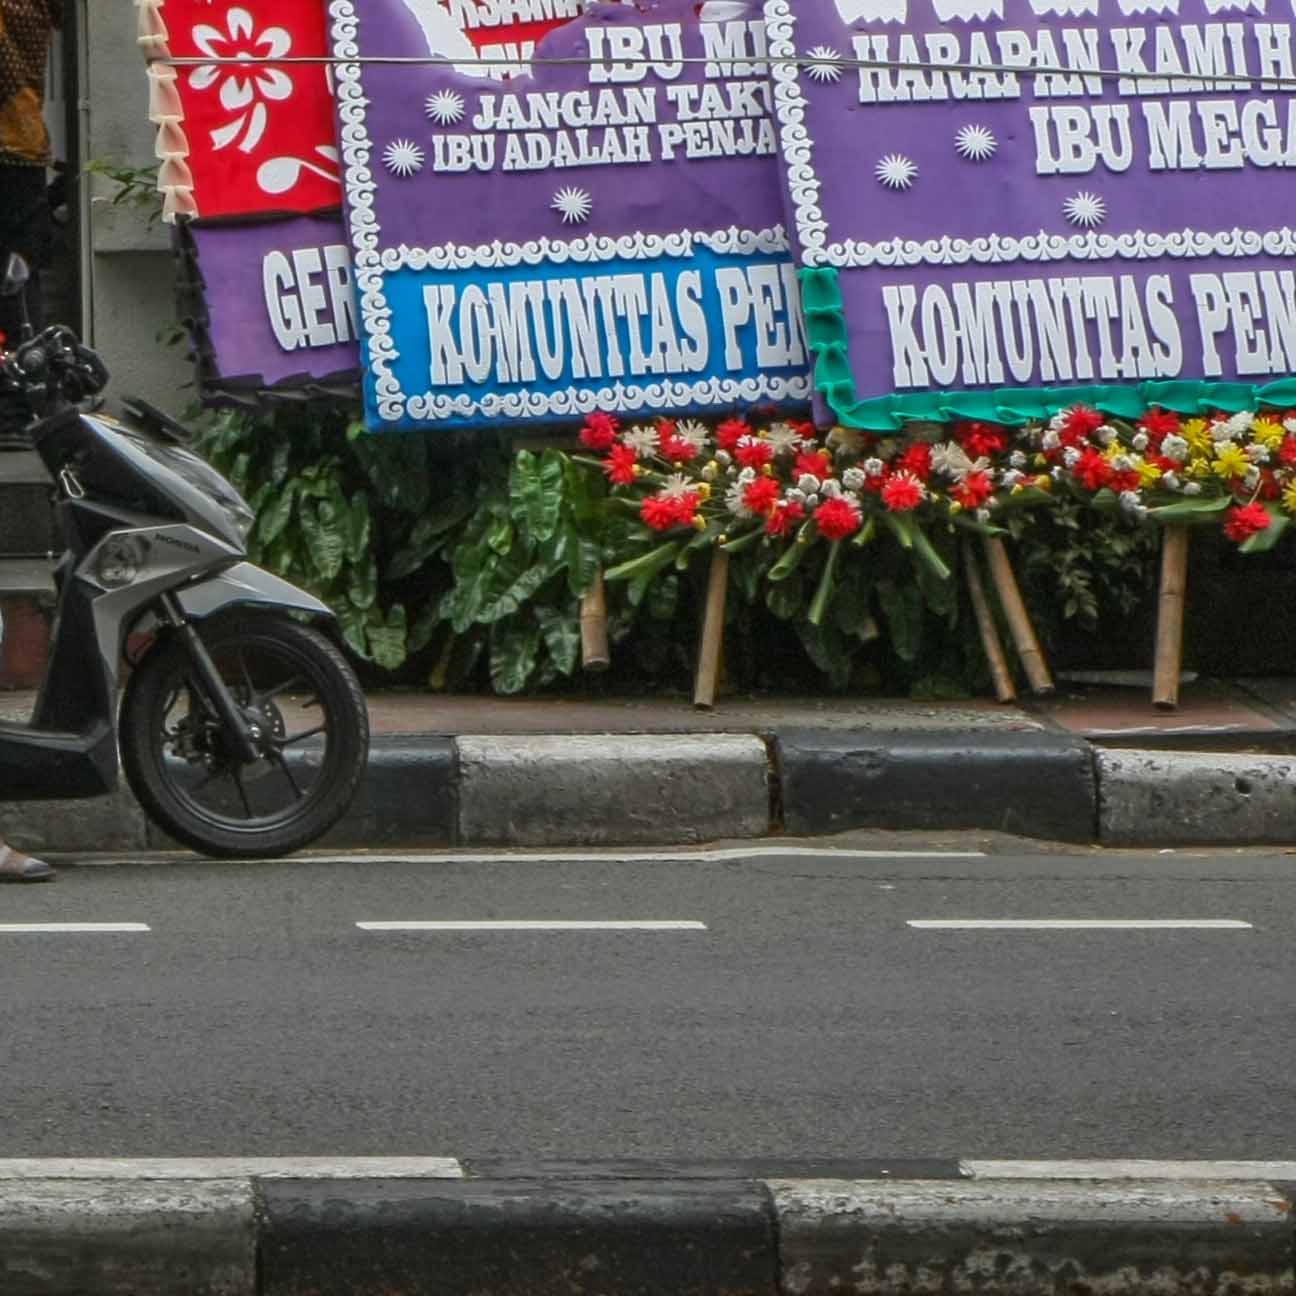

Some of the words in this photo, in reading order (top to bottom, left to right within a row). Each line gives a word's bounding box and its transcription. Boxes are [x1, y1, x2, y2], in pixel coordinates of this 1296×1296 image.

[585, 24, 684, 83] IBU
[852, 28, 1103, 103] HARAPAN
[1110, 23, 1251, 95] KAMI
[432, 134, 495, 172] IBU
[503, 125, 651, 170] ADALAH
[659, 117, 778, 159] PENJA
[473, 87, 656, 131] JANGAN
[1029, 104, 1134, 176] IBU
[423, 271, 709, 386] KOMUNITAS
[882, 275, 1183, 388] KOMUNITAS
